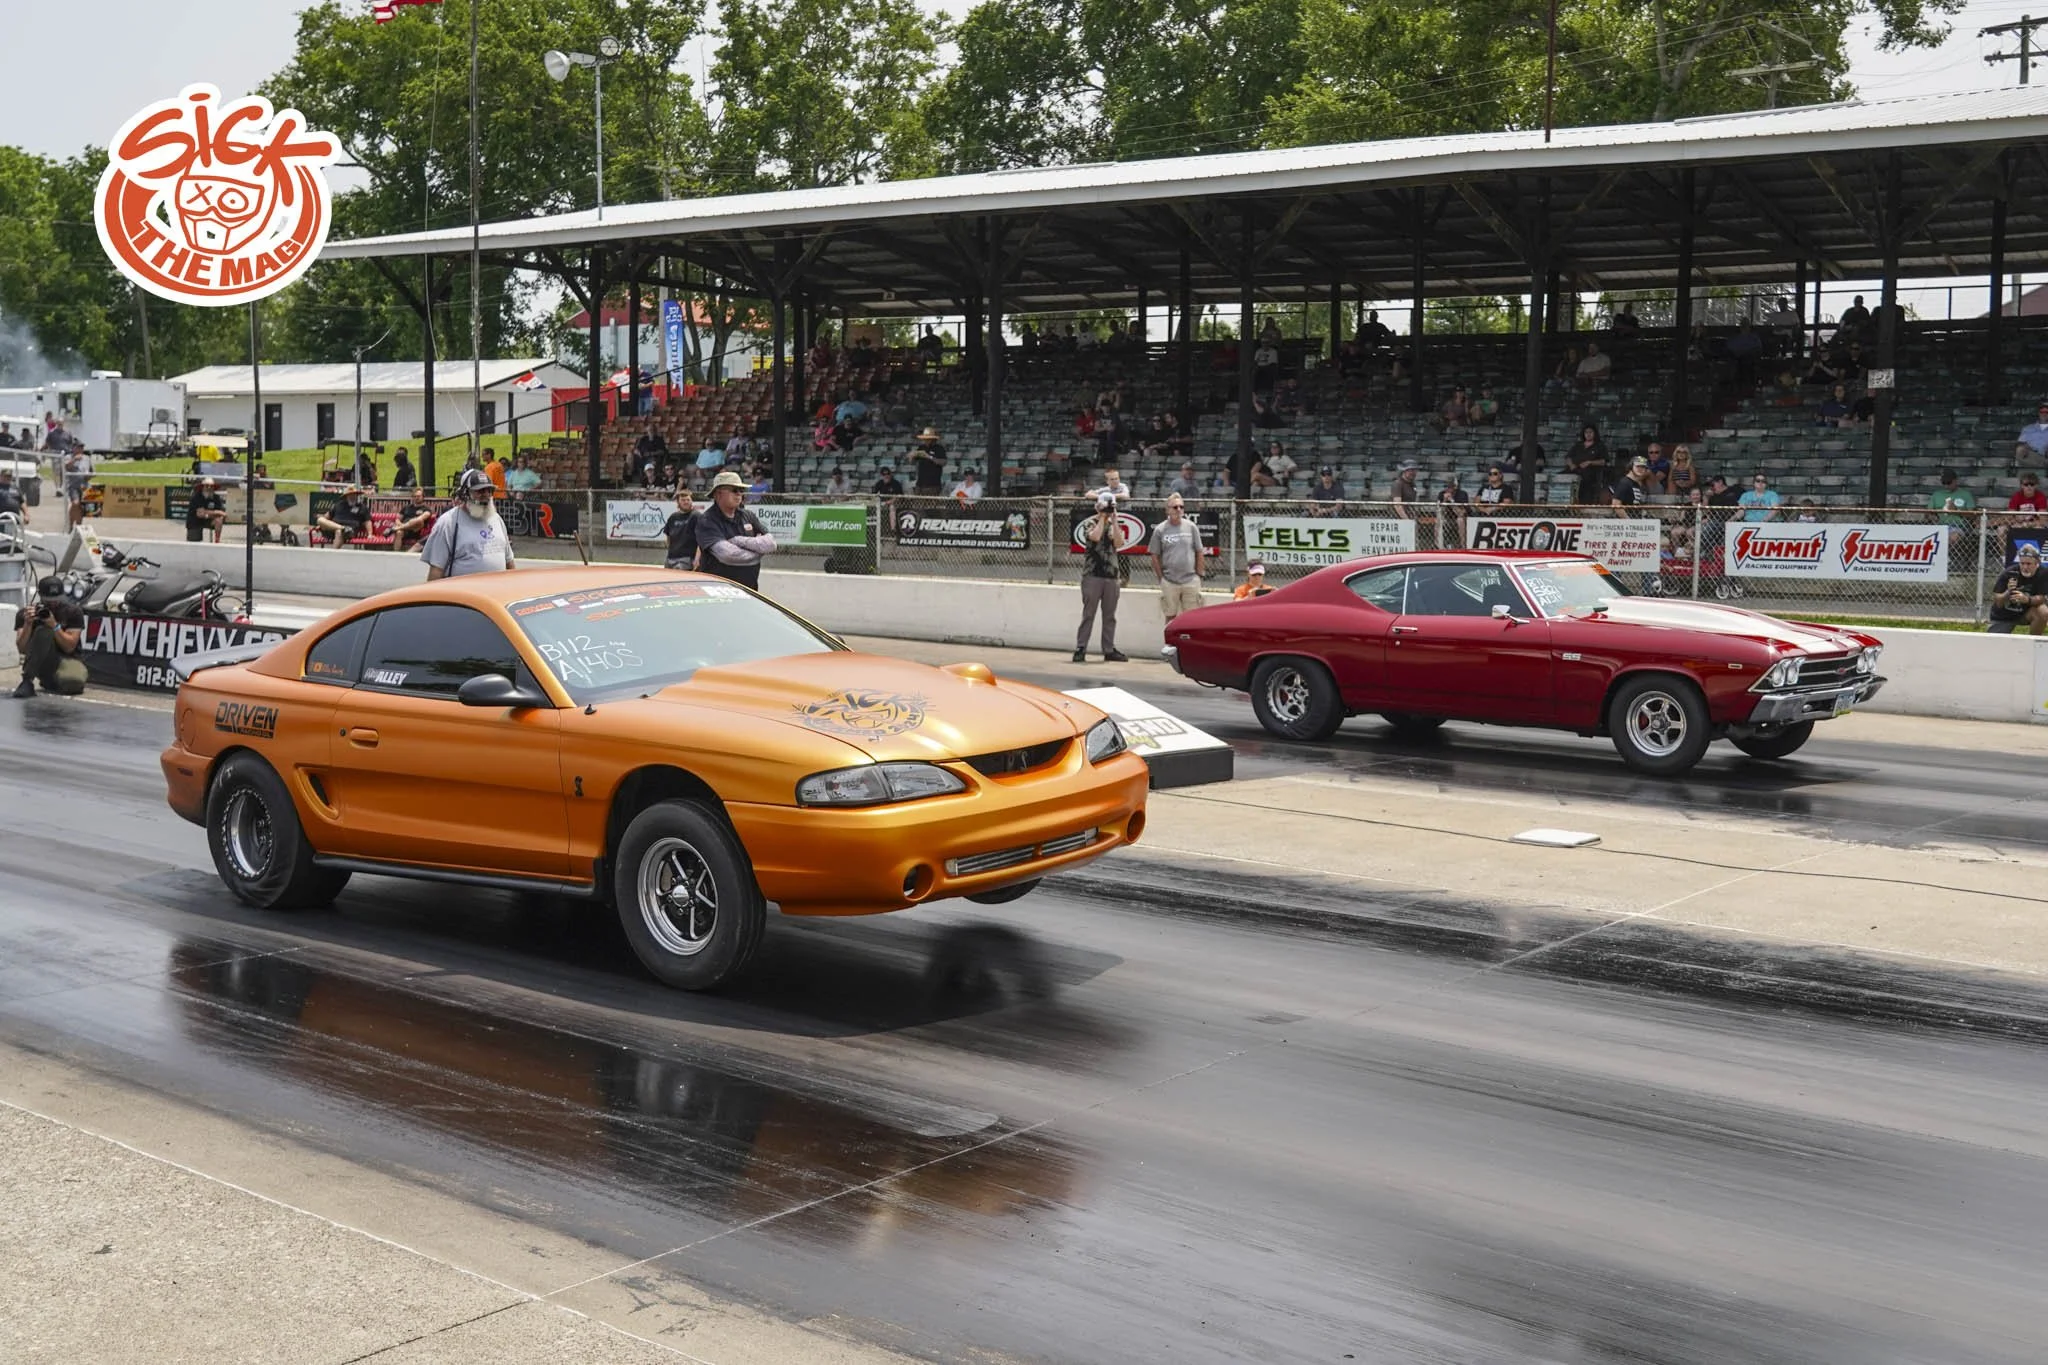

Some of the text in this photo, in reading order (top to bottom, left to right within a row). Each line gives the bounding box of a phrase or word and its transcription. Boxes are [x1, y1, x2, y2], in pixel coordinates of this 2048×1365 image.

[612, 512, 664, 524] KENTUCKY
[758, 508, 797, 519] BOWLING
[770, 519, 797, 528] GREEN
[809, 520, 862, 531] VisitBGKY.com
[918, 518, 1006, 533] RENEGADE
[1370, 523, 1400, 533] REPAIR
[1258, 527, 1351, 548] FELTS
[1370, 534, 1401, 544] TOWING
[919, 538, 942, 546] FUELS
[943, 539, 977, 547] BLENDED
[986, 541, 1027, 549] KENTUCKY
[1584, 541, 1608, 549] TIRES
[1621, 541, 1657, 551] REPAIRS
[1361, 545, 1387, 556] HEAVY
[1592, 550, 1651, 559] JUST 5 MINUTES
[1257, 551, 1343, 564] 270-796-9100
[538, 635, 607, 662] B112
[374, 670, 408, 686] ALLEY
[215, 701, 280, 731] DRIVEN
